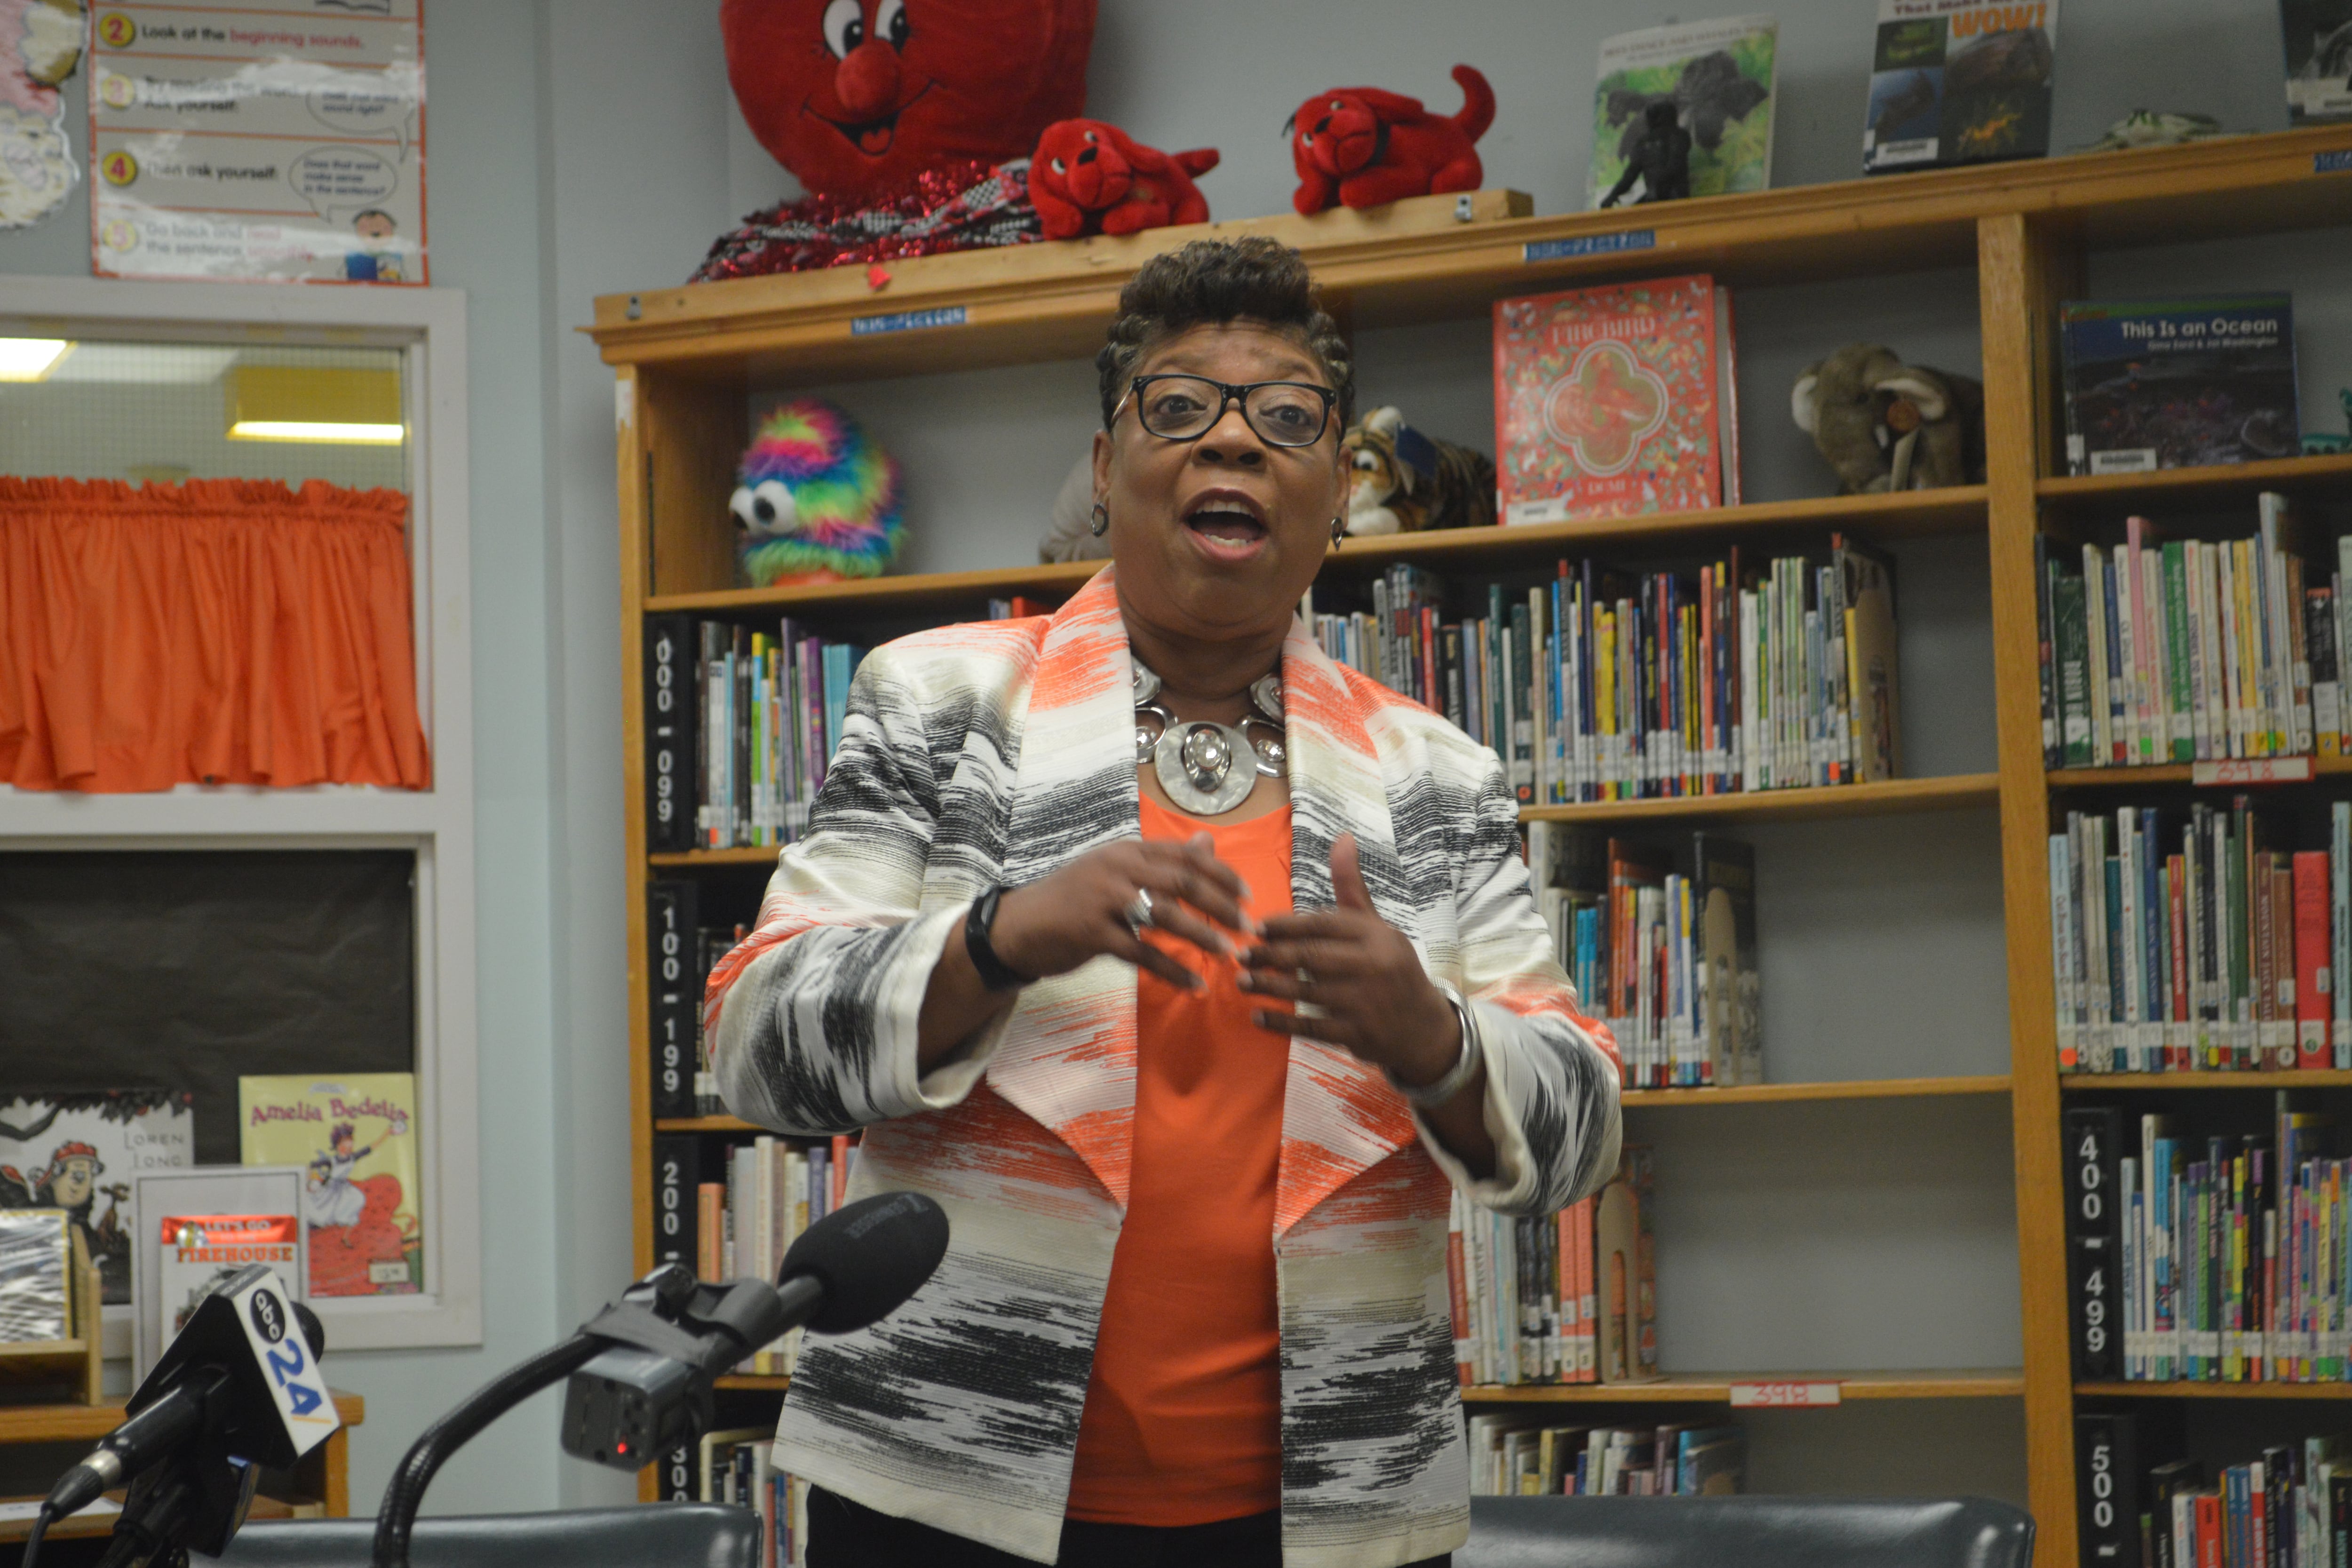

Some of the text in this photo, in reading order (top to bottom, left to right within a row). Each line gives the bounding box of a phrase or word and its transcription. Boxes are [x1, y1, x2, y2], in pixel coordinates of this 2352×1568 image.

[1952, 1, 2047, 38] WOW!
[108, 18, 123, 41] 2
[143, 25, 176, 39] Look
[182, 27, 196, 40] at
[202, 27, 225, 40] the
[230, 27, 304, 49] beginning
[110, 157, 127, 179] 4
[2122, 317, 2279, 338] This Is an Ocean
[2215, 759, 2275, 781] 398
[2260, 894, 2273, 959] MOUNTAIN
[2262, 961, 2273, 991] JACK
[251, 1096, 409, 1127] Amelia Bedelia
[124, 1130, 185, 1151] LOREN
[246, 1219, 271, 1231] GO
[177, 1246, 294, 1264] FIREHOUSE
[266, 1338, 323, 1416] 24
[1750, 1382, 1809, 1405] 398
